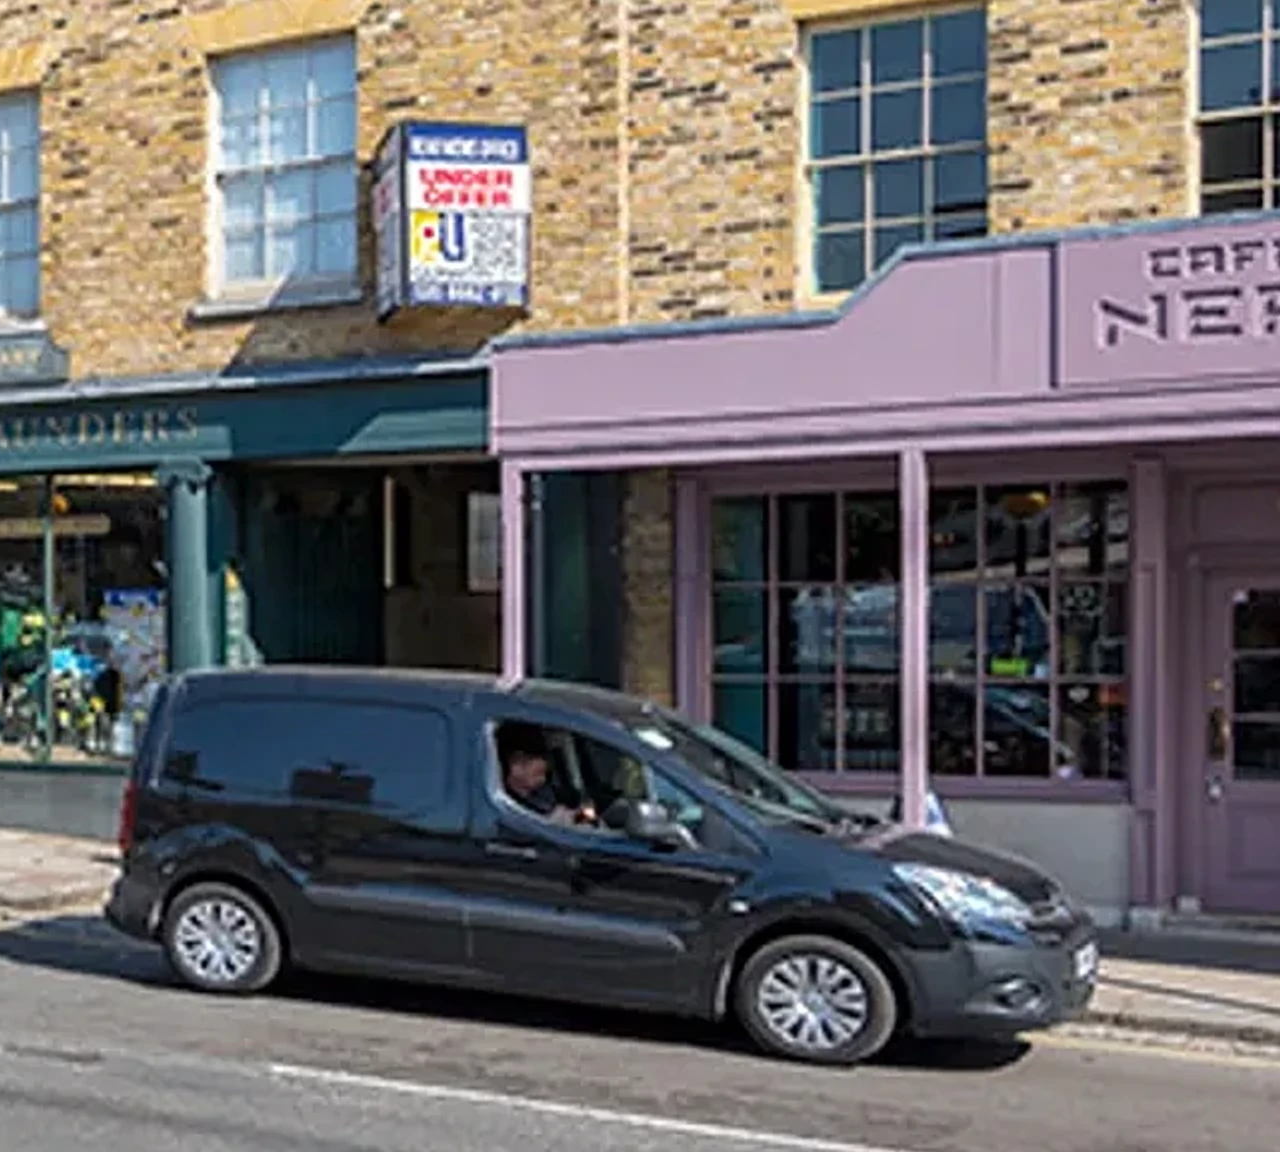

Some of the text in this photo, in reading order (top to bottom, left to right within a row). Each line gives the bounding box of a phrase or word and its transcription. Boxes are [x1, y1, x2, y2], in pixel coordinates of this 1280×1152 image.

[418, 168, 514, 188] UNDER
[421, 187, 513, 206] OFFER
[1148, 239, 1280, 278] CAF
